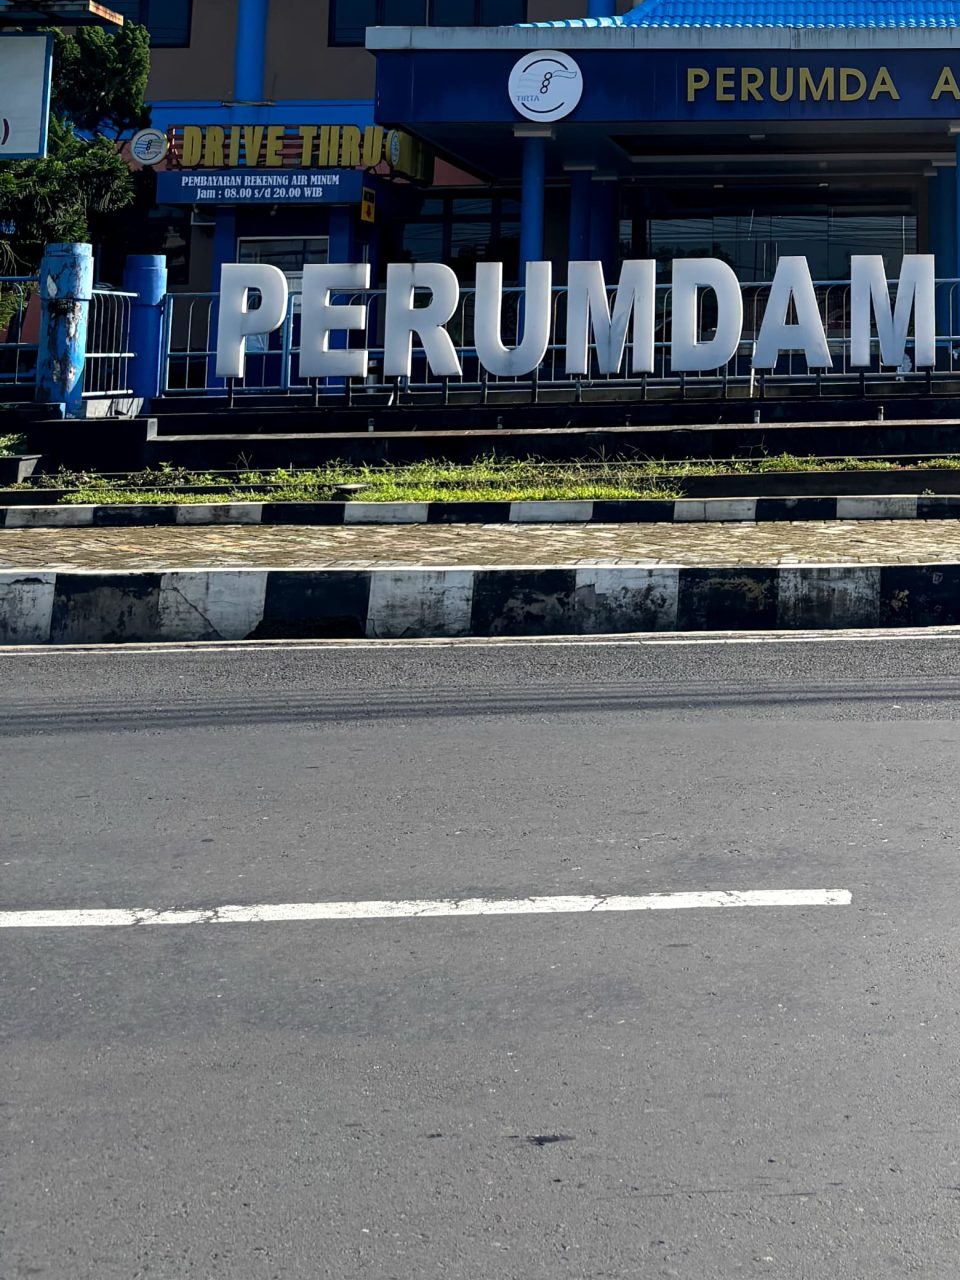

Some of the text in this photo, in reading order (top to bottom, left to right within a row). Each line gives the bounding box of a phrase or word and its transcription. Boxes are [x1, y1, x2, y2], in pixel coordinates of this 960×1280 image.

[687, 66, 900, 102] PERUMDA
[180, 125, 384, 167] DRIVE THRU
[181, 174, 340, 187] PEMBAYARAN REKENING AIR MINUM
[196, 188, 216, 200] Jam
[224, 187, 252, 198] 08.00
[254, 187, 271, 197] s/d
[273, 187, 301, 197] 20.00
[304, 186, 323, 197] WIB
[215, 254, 936, 378] PERUMDAM
